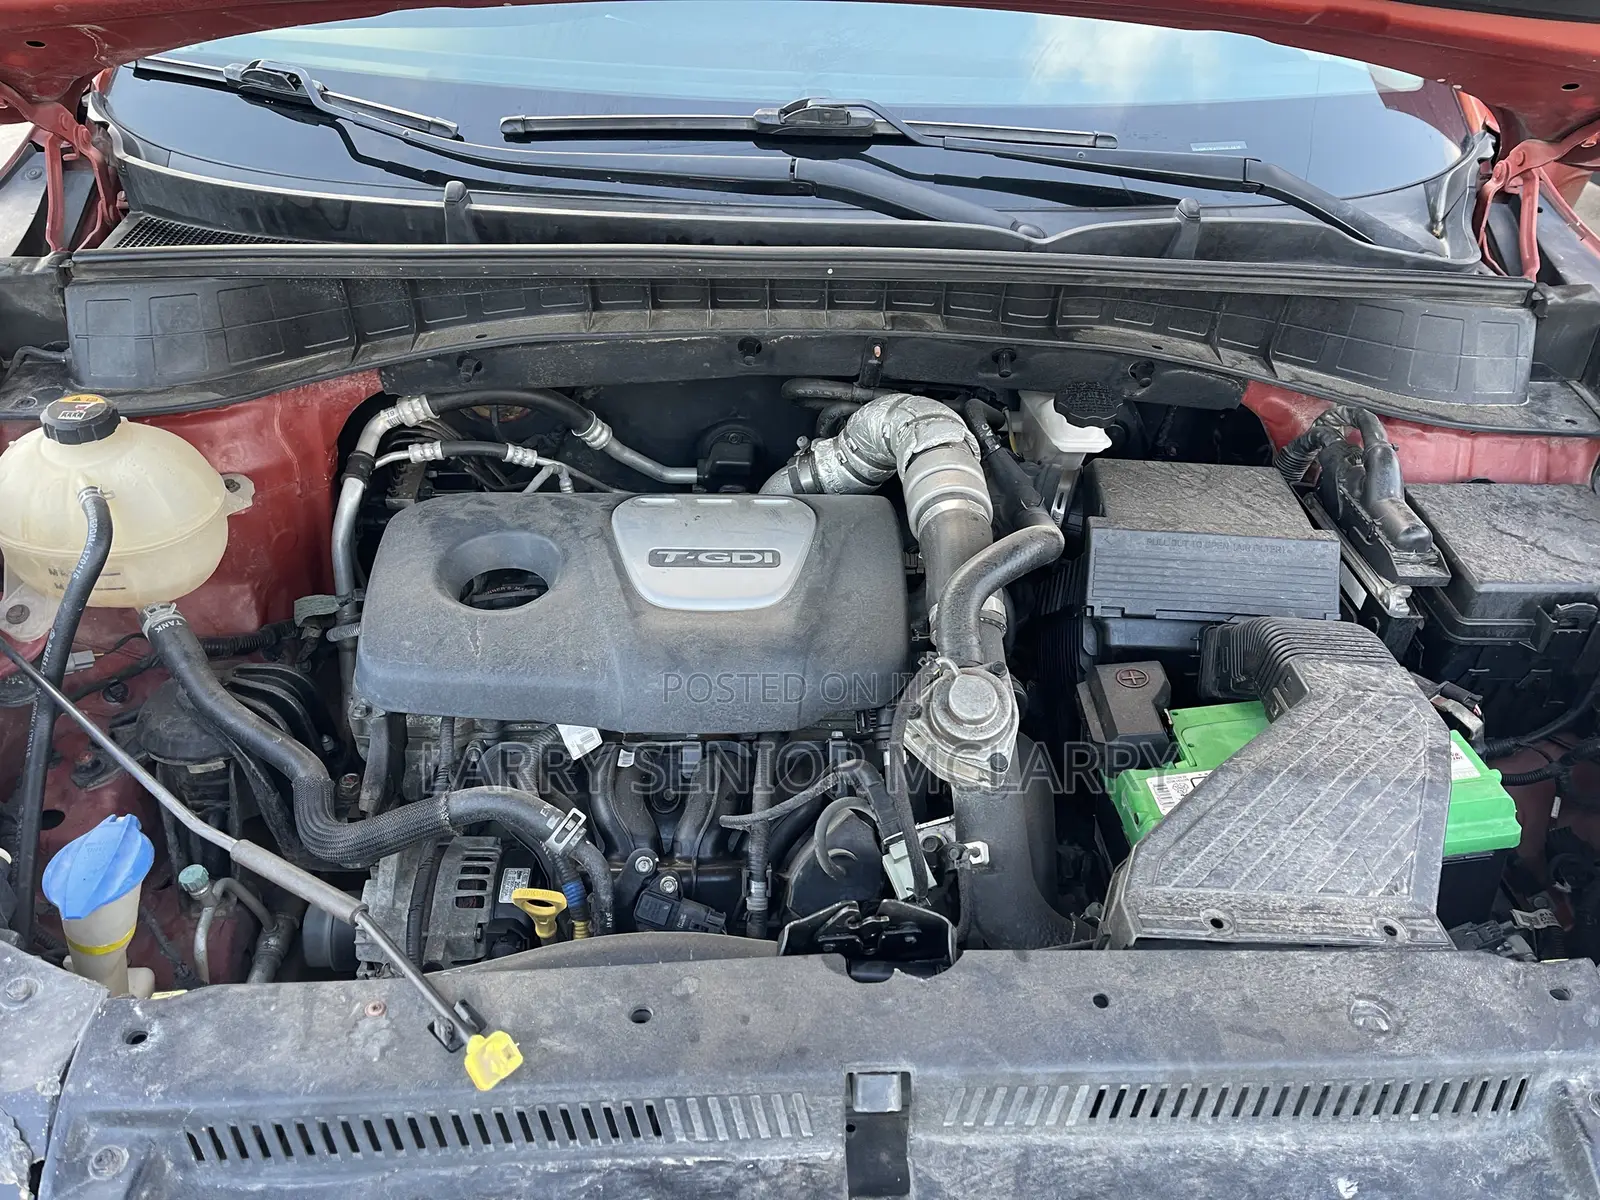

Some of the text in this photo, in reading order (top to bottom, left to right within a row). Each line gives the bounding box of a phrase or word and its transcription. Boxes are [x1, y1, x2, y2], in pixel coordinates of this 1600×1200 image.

[1146, 537, 1169, 547] PULL
[1171, 538, 1189, 548] OUT
[1191, 540, 1202, 548] TO
[1204, 541, 1230, 550] OPEN
[656, 551, 773, 564] T-GDI
[154, 620, 183, 633] TANK
